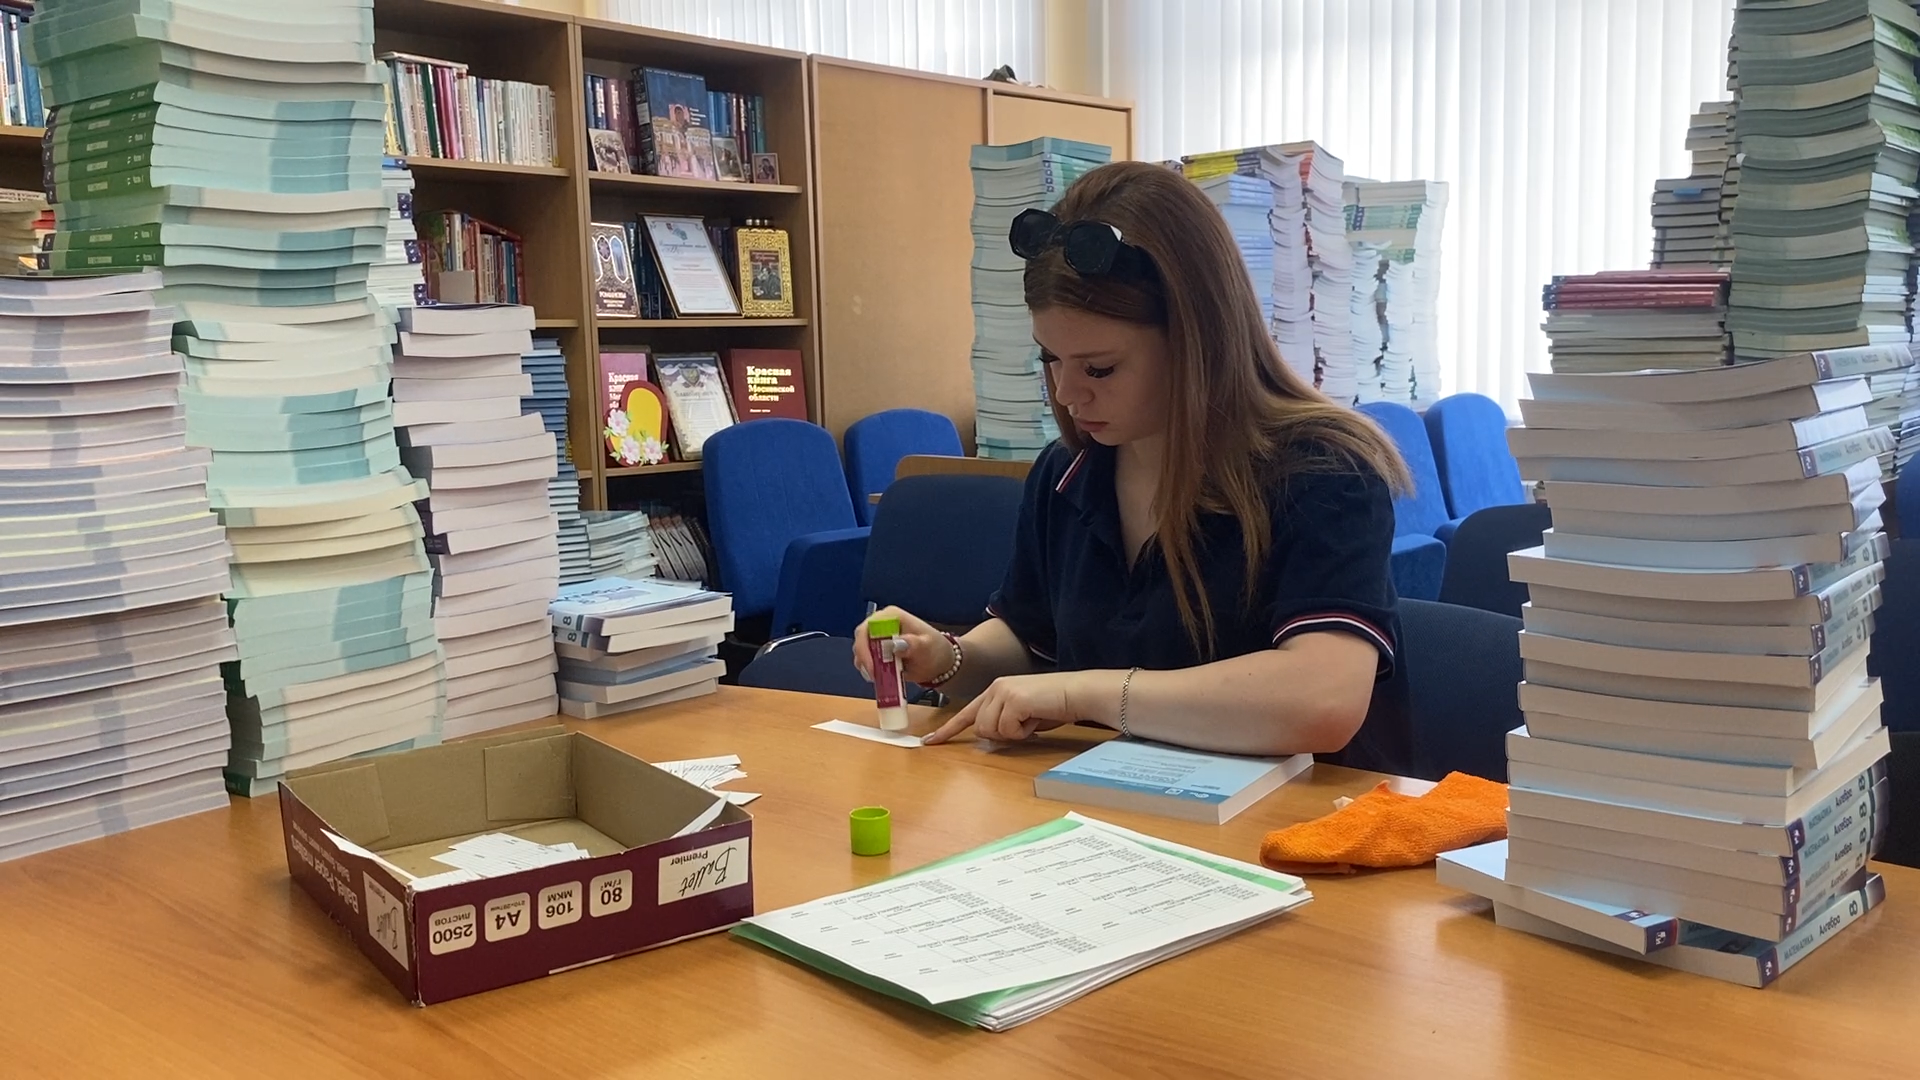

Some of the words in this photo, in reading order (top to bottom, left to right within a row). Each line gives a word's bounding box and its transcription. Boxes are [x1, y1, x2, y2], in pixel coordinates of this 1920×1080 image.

[608, 372, 639, 384] Красная
[746, 365, 792, 378] Красная
[747, 377, 778, 385] книга
[748, 385, 795, 393] Московской
[748, 393, 779, 402] области
[562, 616, 572, 626] 8
[567, 632, 578, 642] 8
[1835, 787, 1853, 807] Алгебра
[1833, 815, 1853, 835] Алгебра
[1858, 802, 1867, 818] 8
[670, 850, 709, 866] Premier
[1834, 842, 1853, 862] Алгебра
[677, 846, 738, 897] Ballet
[601, 886, 623, 905] 80
[545, 901, 574, 918] 106
[494, 910, 522, 931] A4
[432, 923, 473, 944] 2500
[1783, 934, 1814, 961] МАТЕМАТИКА
[1818, 914, 1841, 936] Алгебра
[1848, 900, 1858, 917] 8
